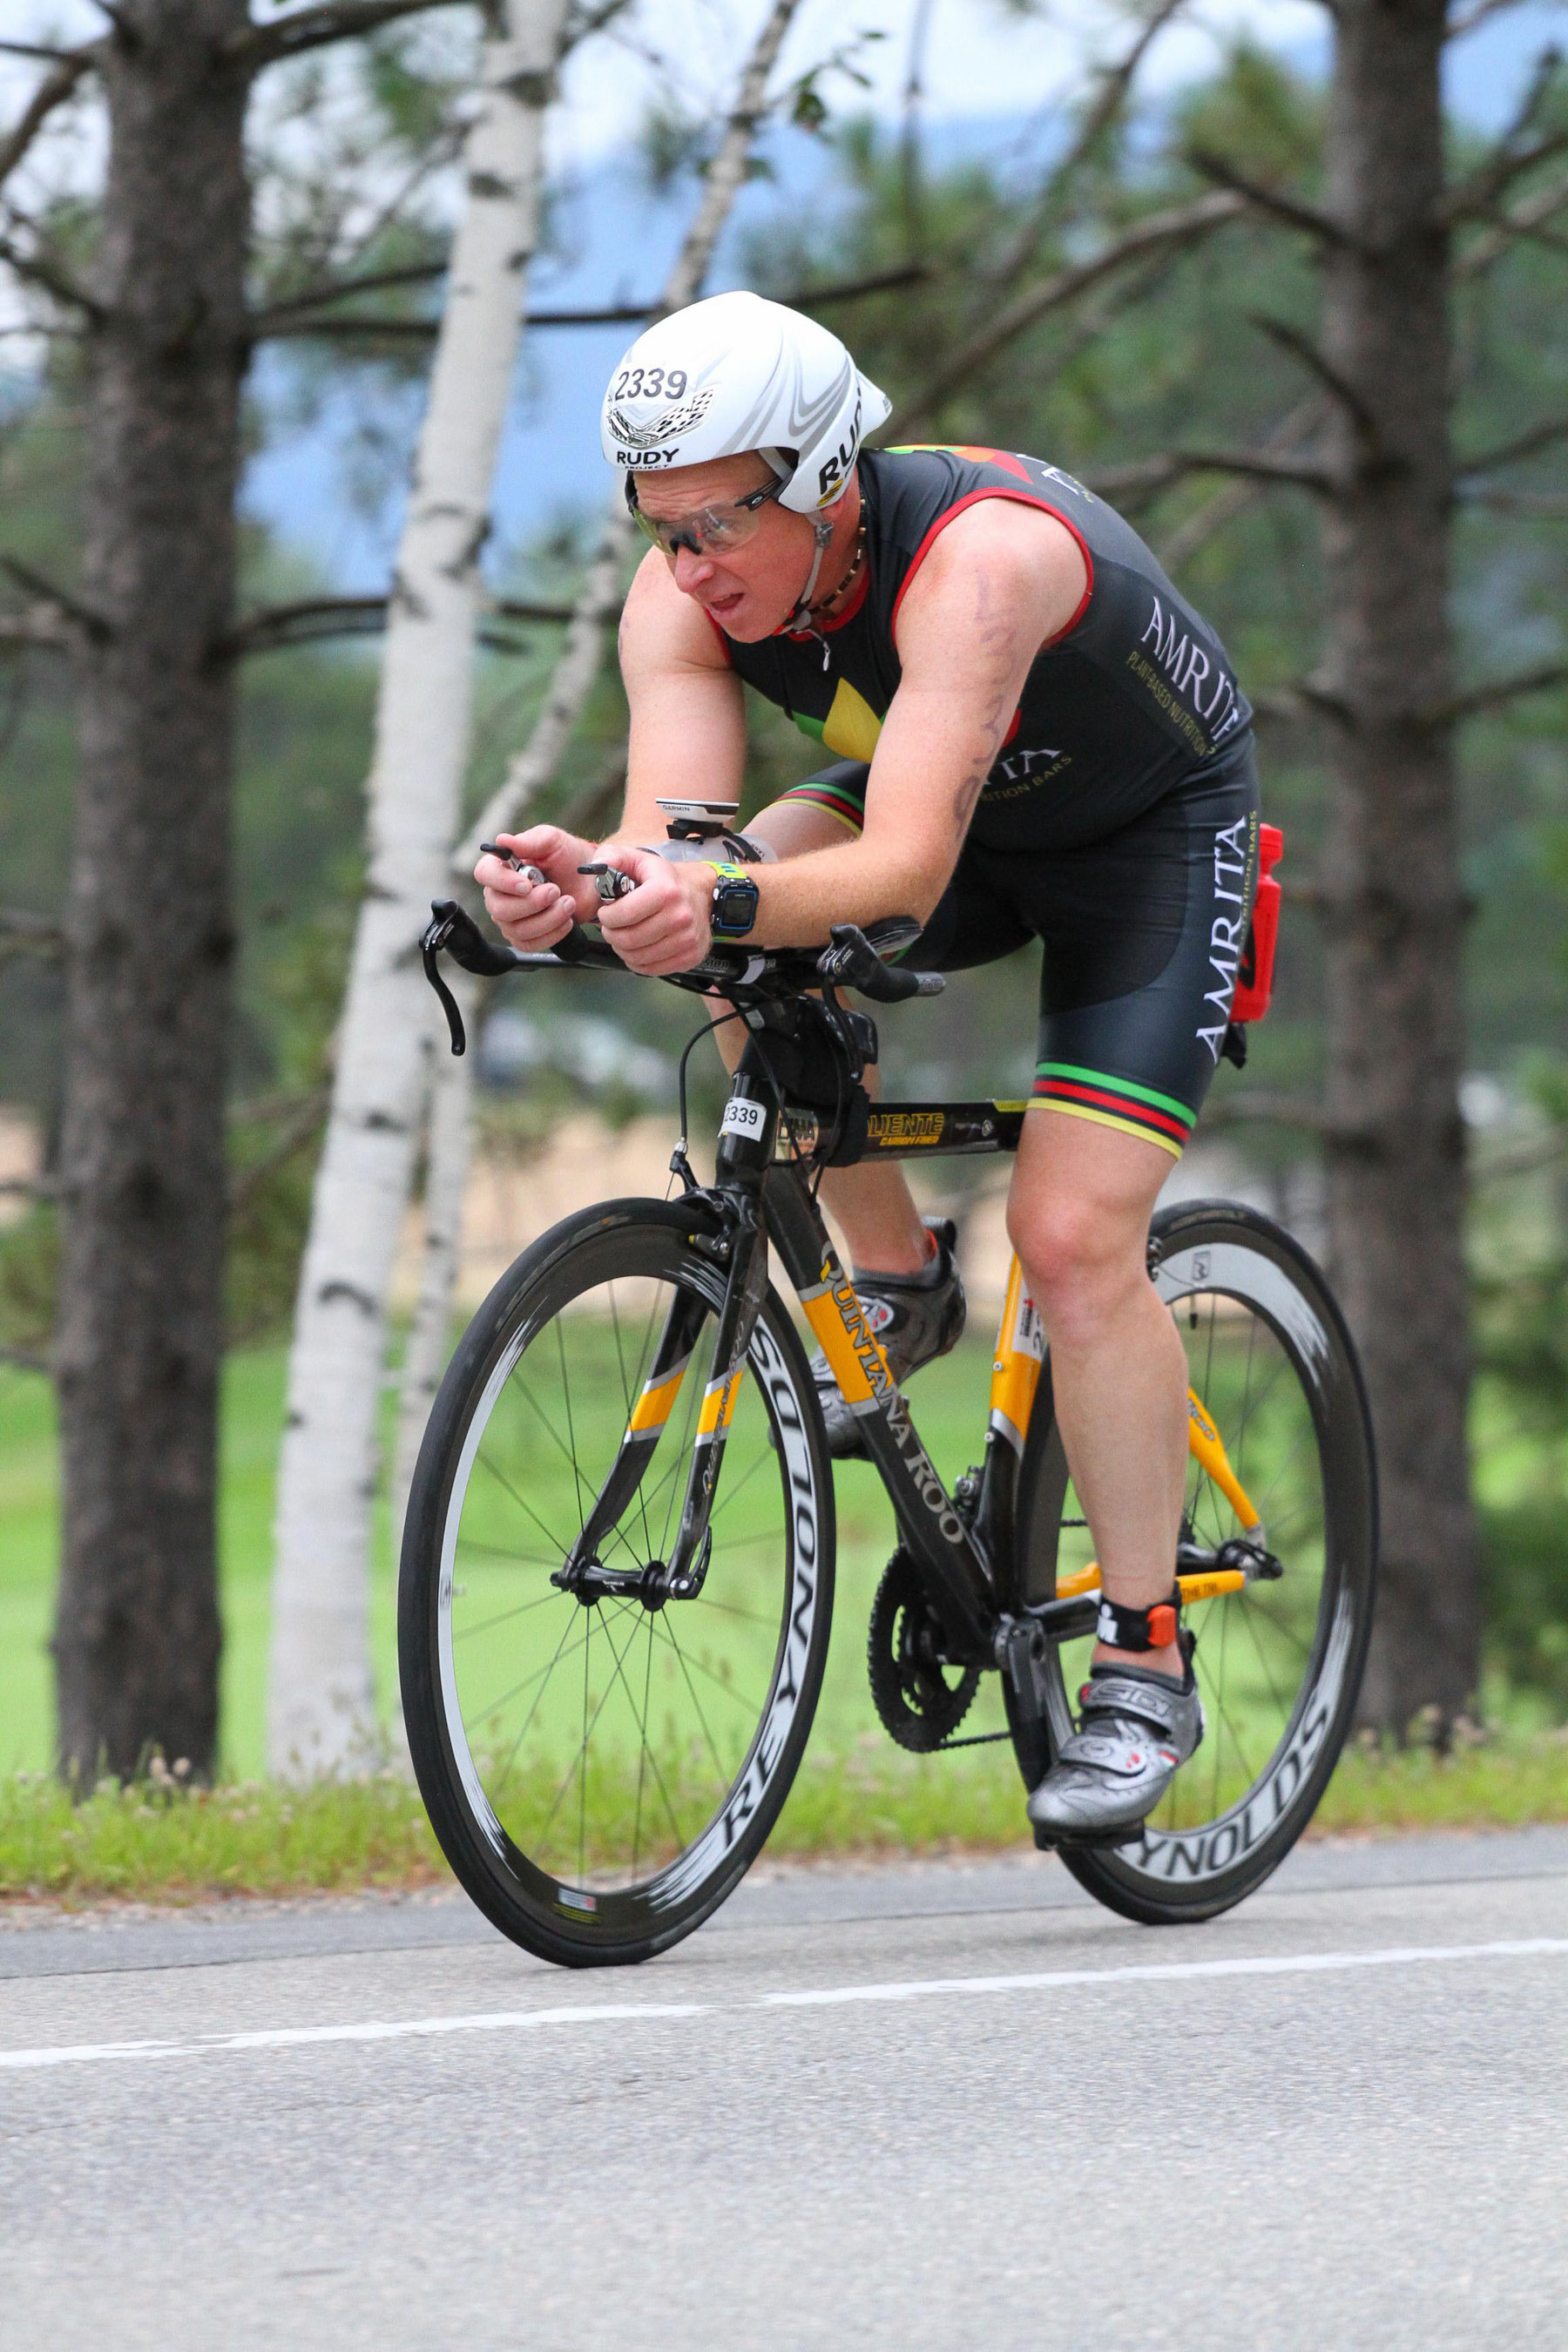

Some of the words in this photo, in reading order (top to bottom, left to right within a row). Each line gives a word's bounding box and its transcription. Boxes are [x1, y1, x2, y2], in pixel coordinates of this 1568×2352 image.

[615, 368, 687, 401] 2339
[617, 449, 679, 464] RUDY
[1032, 754, 1072, 786] BARS
[1195, 815, 1247, 1065] AMRITA
[868, 1112, 944, 1138] LIENTE
[820, 1240, 912, 1450] QUINTANA
[903, 1450, 963, 1544] ROO
[725, 1325, 814, 1848] REYNOLDS
[1138, 1692, 1327, 1876] YNOLDS
